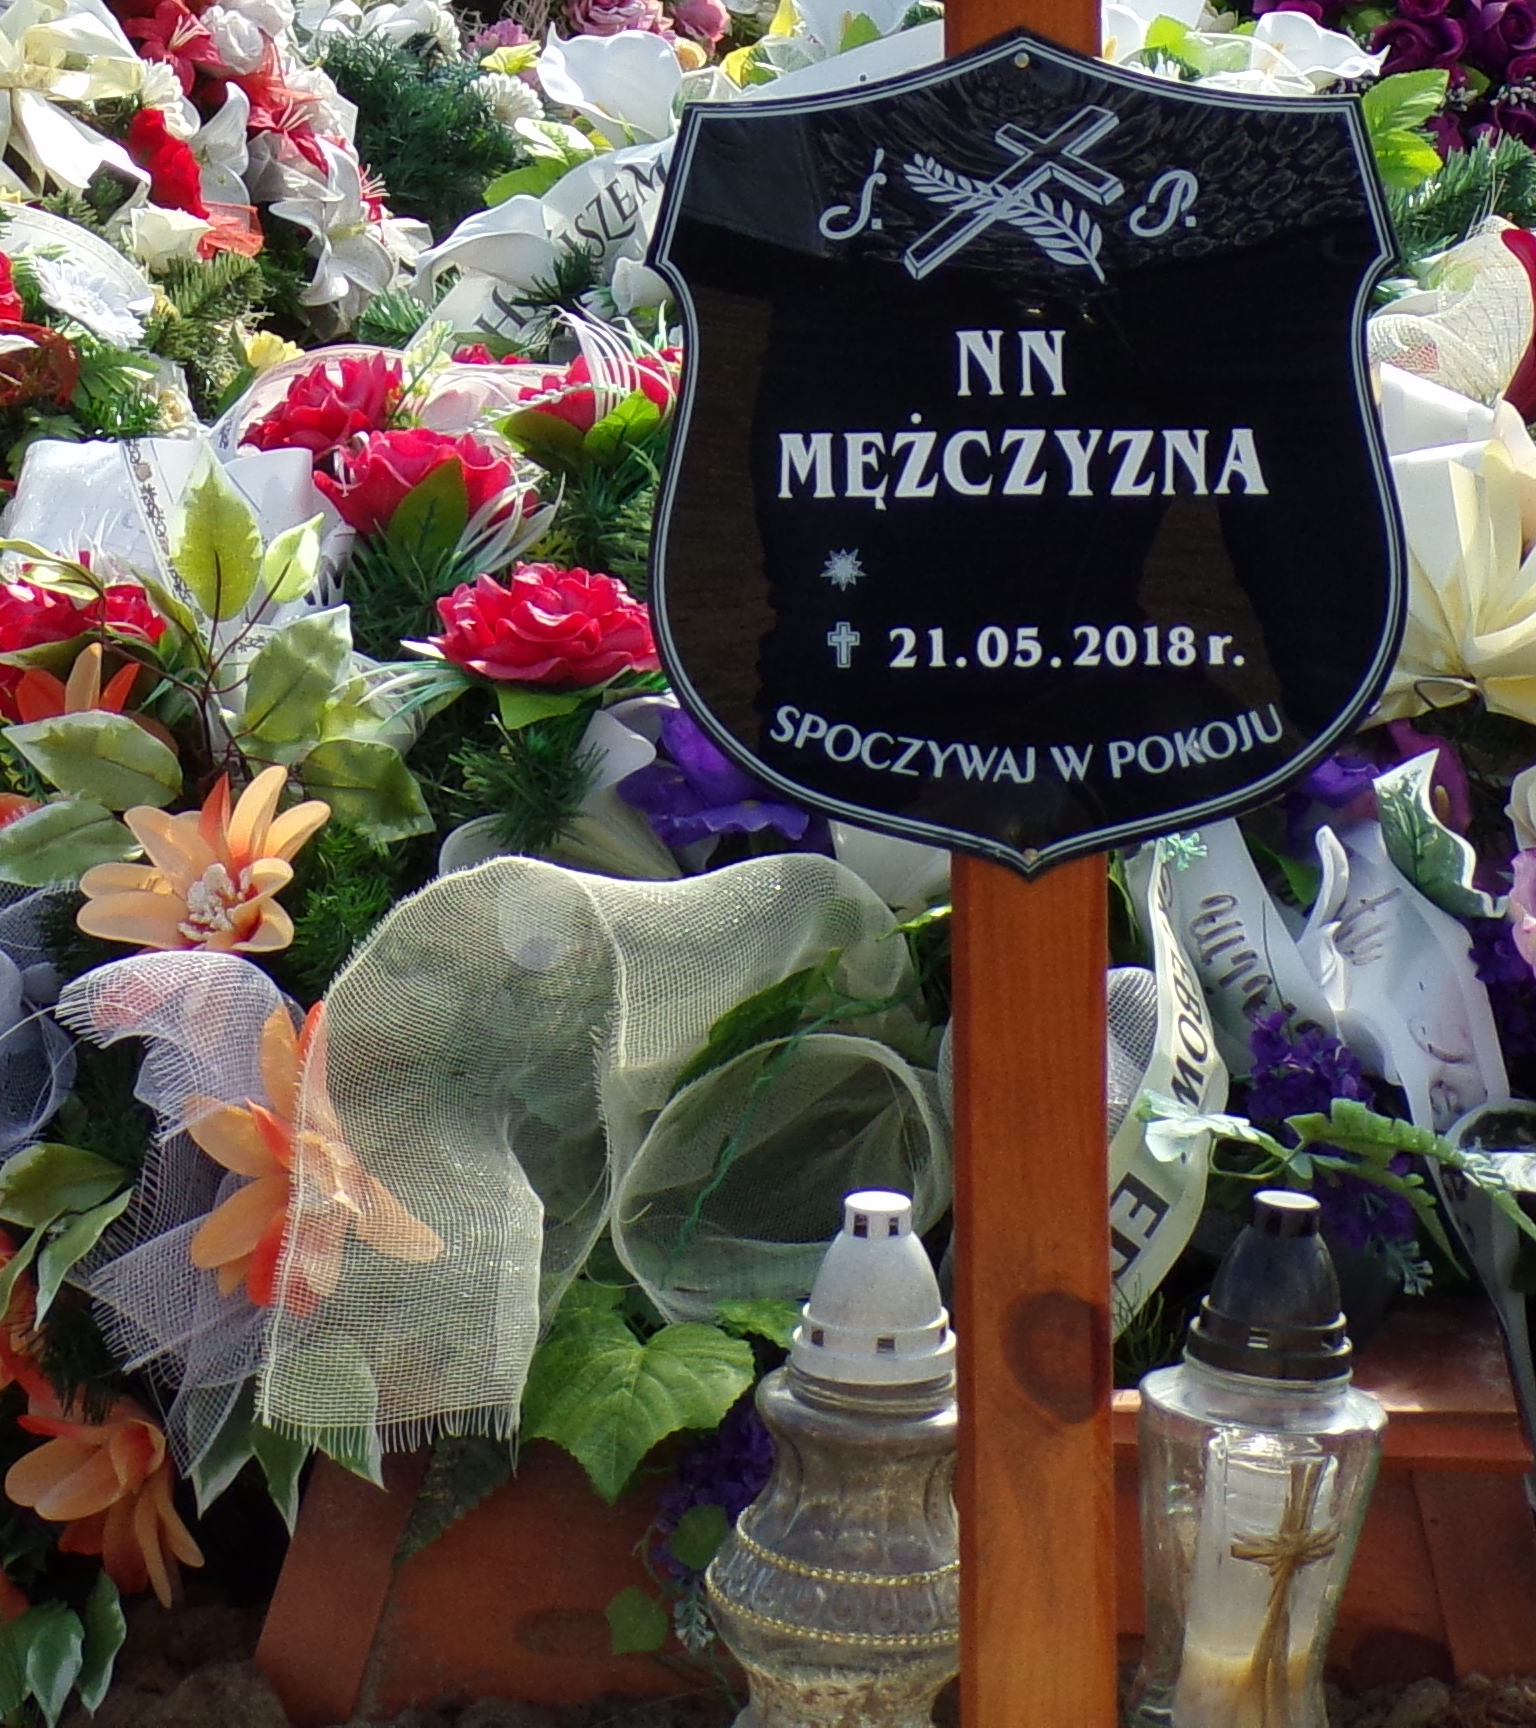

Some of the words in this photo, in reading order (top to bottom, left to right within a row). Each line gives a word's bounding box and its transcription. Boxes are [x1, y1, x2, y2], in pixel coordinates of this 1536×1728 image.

[1129, 169, 1199, 238] P.
[956, 329, 1067, 398] NN
[777, 412, 1270, 512] MĘŻCZYZNA
[769, 704, 1035, 784] SPOCZYWAJ
[1050, 744, 1094, 780] W
[1110, 702, 1284, 779] POKOJU
